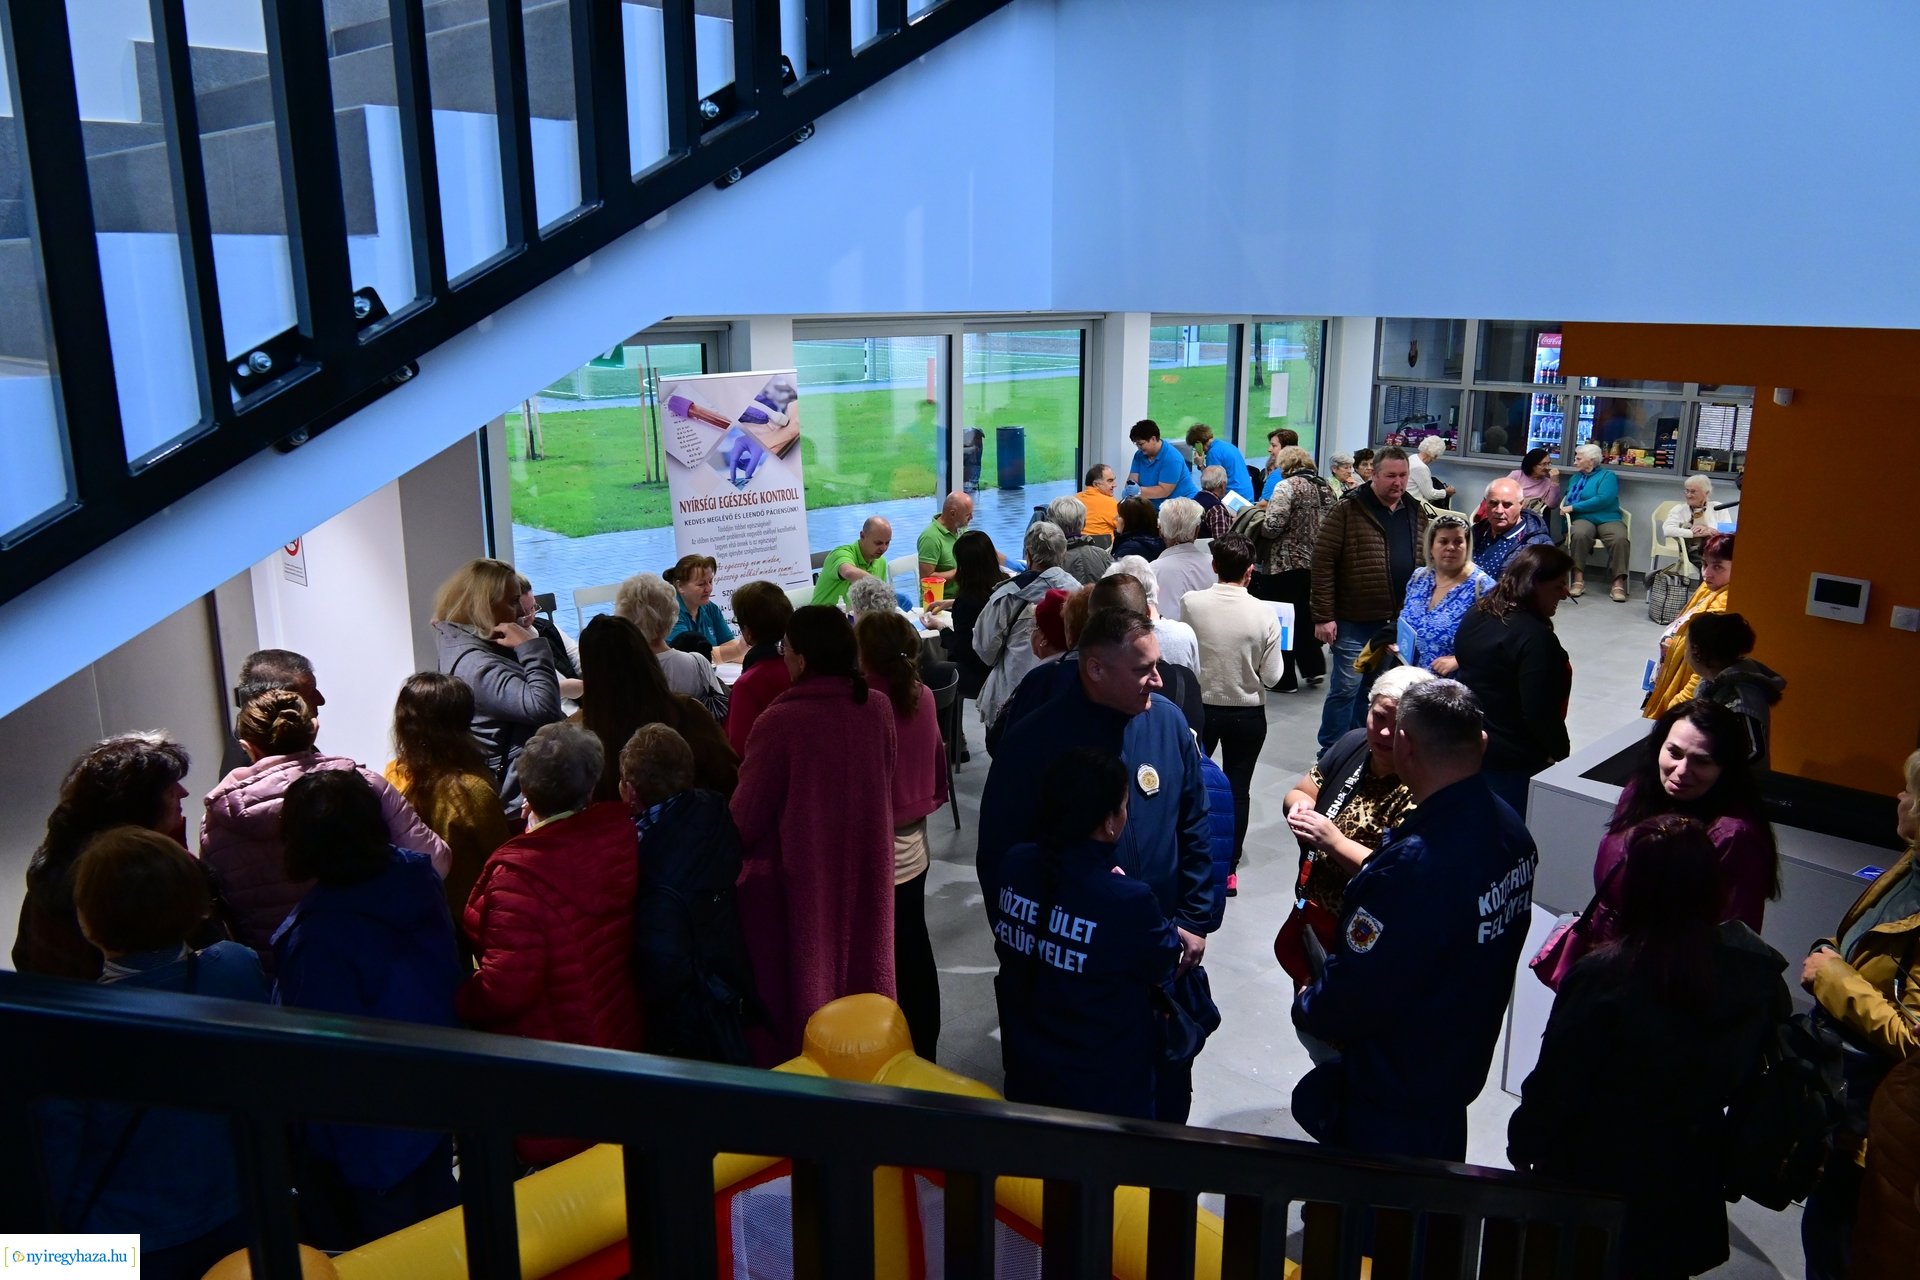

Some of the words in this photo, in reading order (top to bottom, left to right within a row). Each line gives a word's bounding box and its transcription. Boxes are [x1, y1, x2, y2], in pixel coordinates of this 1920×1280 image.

[679, 496, 717, 514] NYÍRSÉGI
[719, 490, 758, 509] EGÉSZSÉG
[760, 487, 799, 504] KONTROLL
[684, 517, 706, 526] KEDVES
[734, 512, 742, 520] ÉS
[742, 509, 765, 519] LEENDŐ
[998, 886, 1098, 944] KÖZTEÜLET
